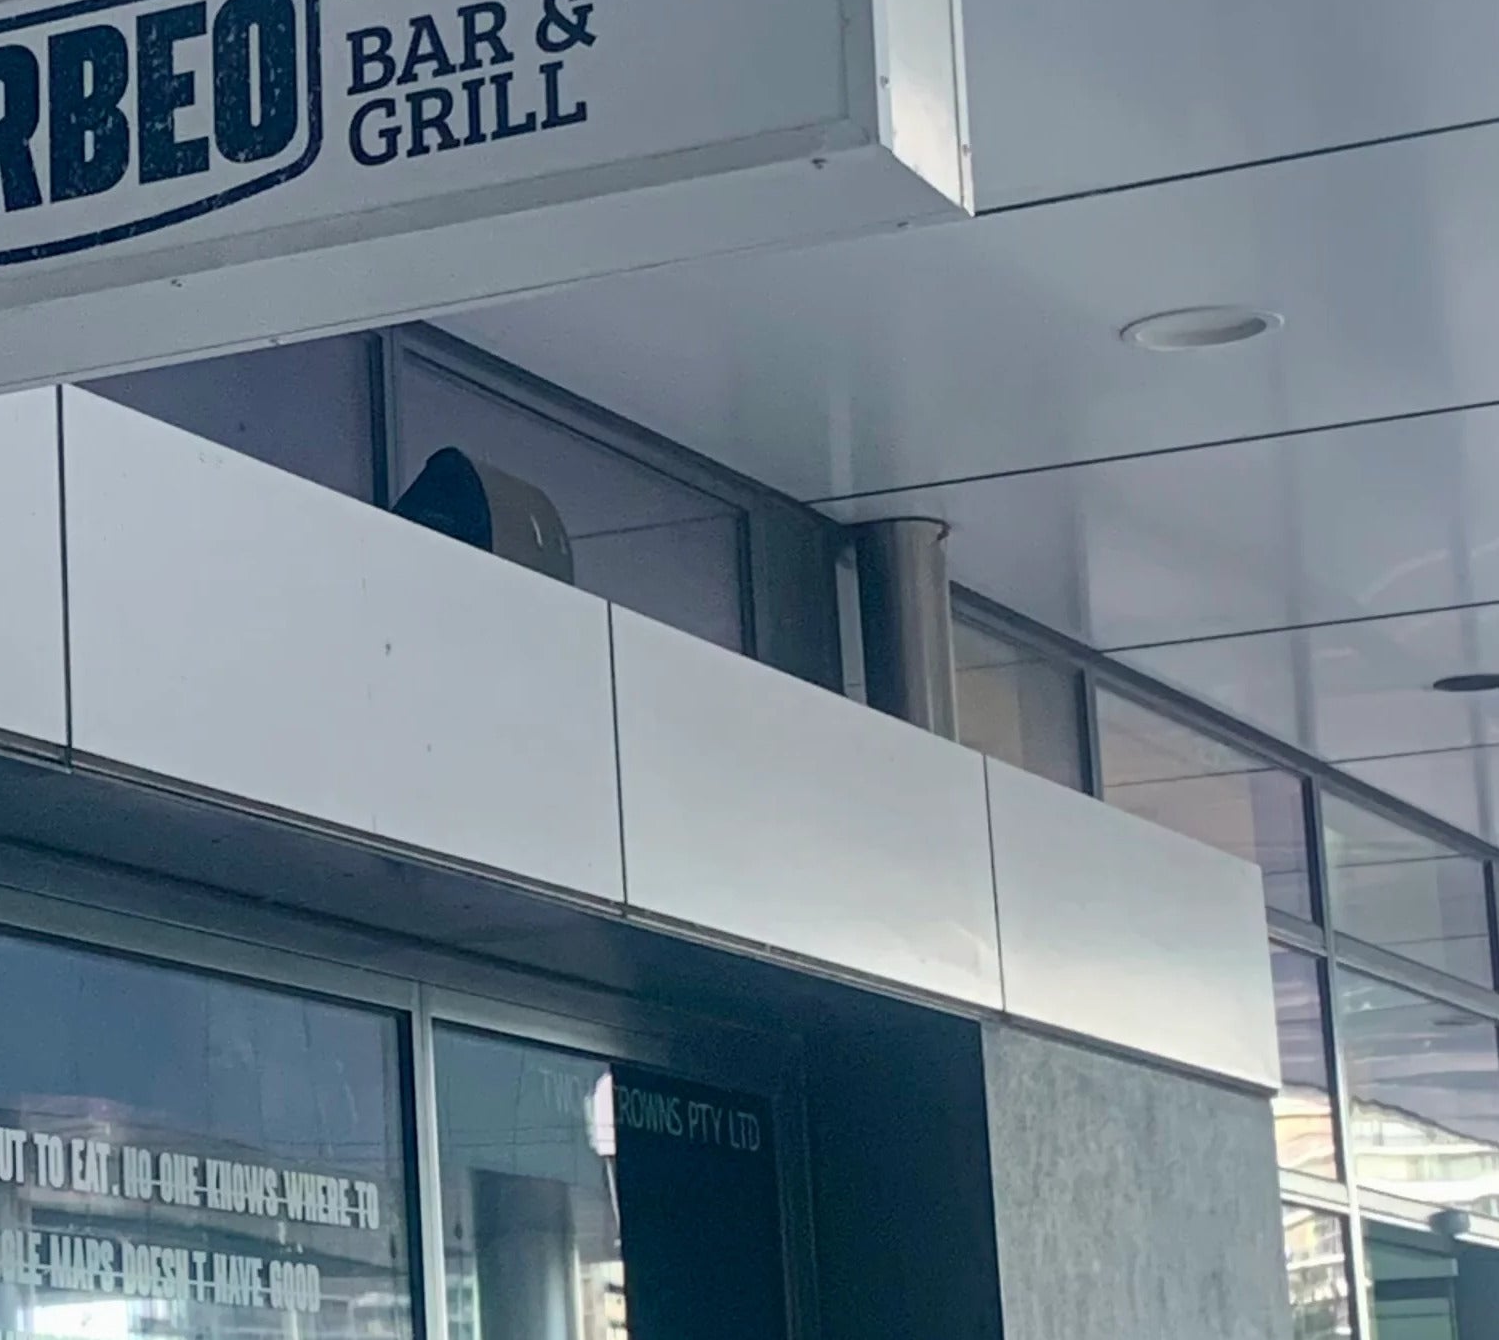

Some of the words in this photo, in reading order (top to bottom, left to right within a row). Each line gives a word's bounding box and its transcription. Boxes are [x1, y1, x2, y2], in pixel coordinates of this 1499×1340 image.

[346, 1, 514, 96] BAR
[347, 61, 588, 167] GRILL
[614, 1084, 684, 1136] ROWNS
[688, 1100, 723, 1145] PTY
[729, 1110, 761, 1152] LTD
[33, 1132, 64, 1188] TO
[71, 1138, 119, 1196] EAT.
[123, 1146, 151, 1199] NO
[159, 1152, 199, 1206] ONE
[206, 1158, 278, 1216] KNOWS
[283, 1170, 350, 1226] WHERE
[354, 1180, 379, 1229] TO
[51, 1234, 115, 1293] MAPS
[213, 1252, 263, 1306] HAVE
[269, 1260, 321, 1312] GOOD
